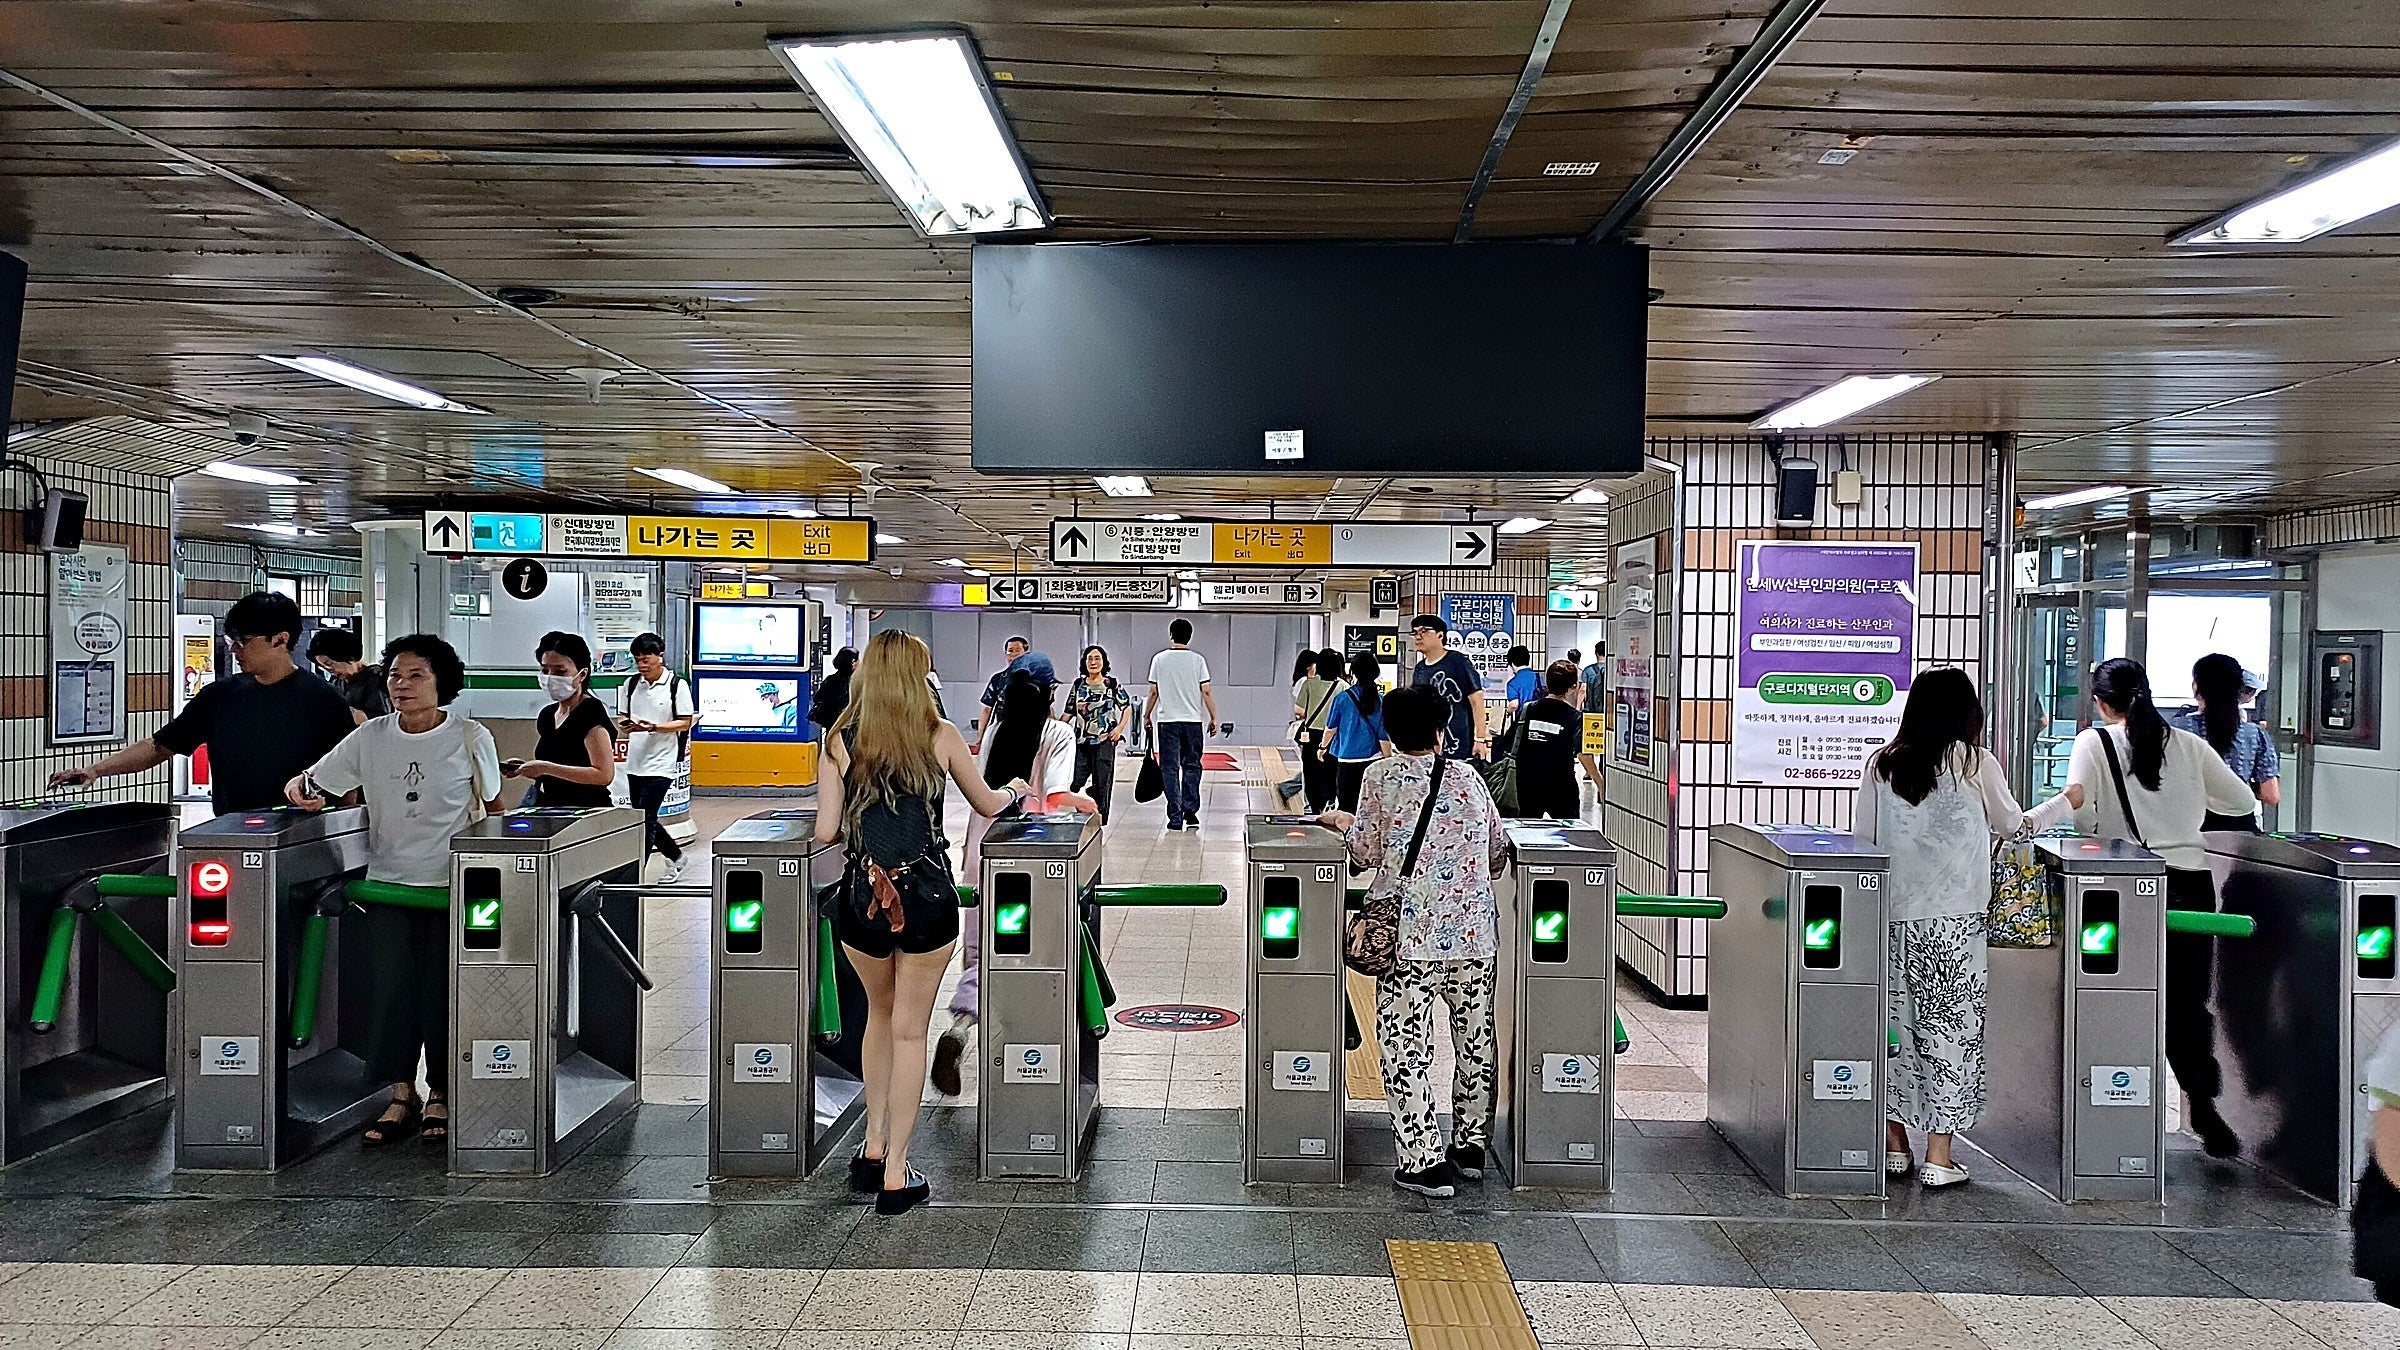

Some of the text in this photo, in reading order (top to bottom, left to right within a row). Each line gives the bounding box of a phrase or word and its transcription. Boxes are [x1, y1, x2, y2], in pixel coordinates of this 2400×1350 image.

[564, 518, 615, 530] 신대방방면
[803, 524, 831, 538] Exit
[1234, 526, 1307, 547] 나가는 곳
[638, 525, 756, 553] 나가는 곳
[803, 541, 831, 556] 出口
[1121, 544, 1181, 555] 신대방방면
[1234, 549, 1251, 559] Exit
[1287, 550, 1304, 559] 出口
[1045, 592, 1065, 600] Ticket
[1066, 592, 1091, 600] Vending
[1091, 592, 1104, 600] and
[1104, 592, 1120, 600] Card
[1213, 585, 1270, 595] 엘리베이터
[1450, 599, 1504, 612] 구로디지털
[1450, 611, 1504, 625] 바른본의원
[1759, 616, 1893, 631] 여의사가 진료하는 산부인과
[1381, 637, 1392, 653] 6
[1467, 637, 1485, 648] 관절
[1491, 638, 1510, 649] 통증
[1763, 682, 1851, 696] 구로디지털단지역
[1859, 683, 1869, 697] 6
[1784, 768, 1862, 780] 02-866-9229
[245, 853, 261, 868] 12
[518, 858, 534, 871] 11
[780, 862, 796, 875] 10
[1048, 864, 1064, 877] 09
[1317, 867, 1333, 880] 08
[1587, 871, 1604, 884] 07
[1860, 875, 1877, 889] 06
[2138, 880, 2155, 894] 05
